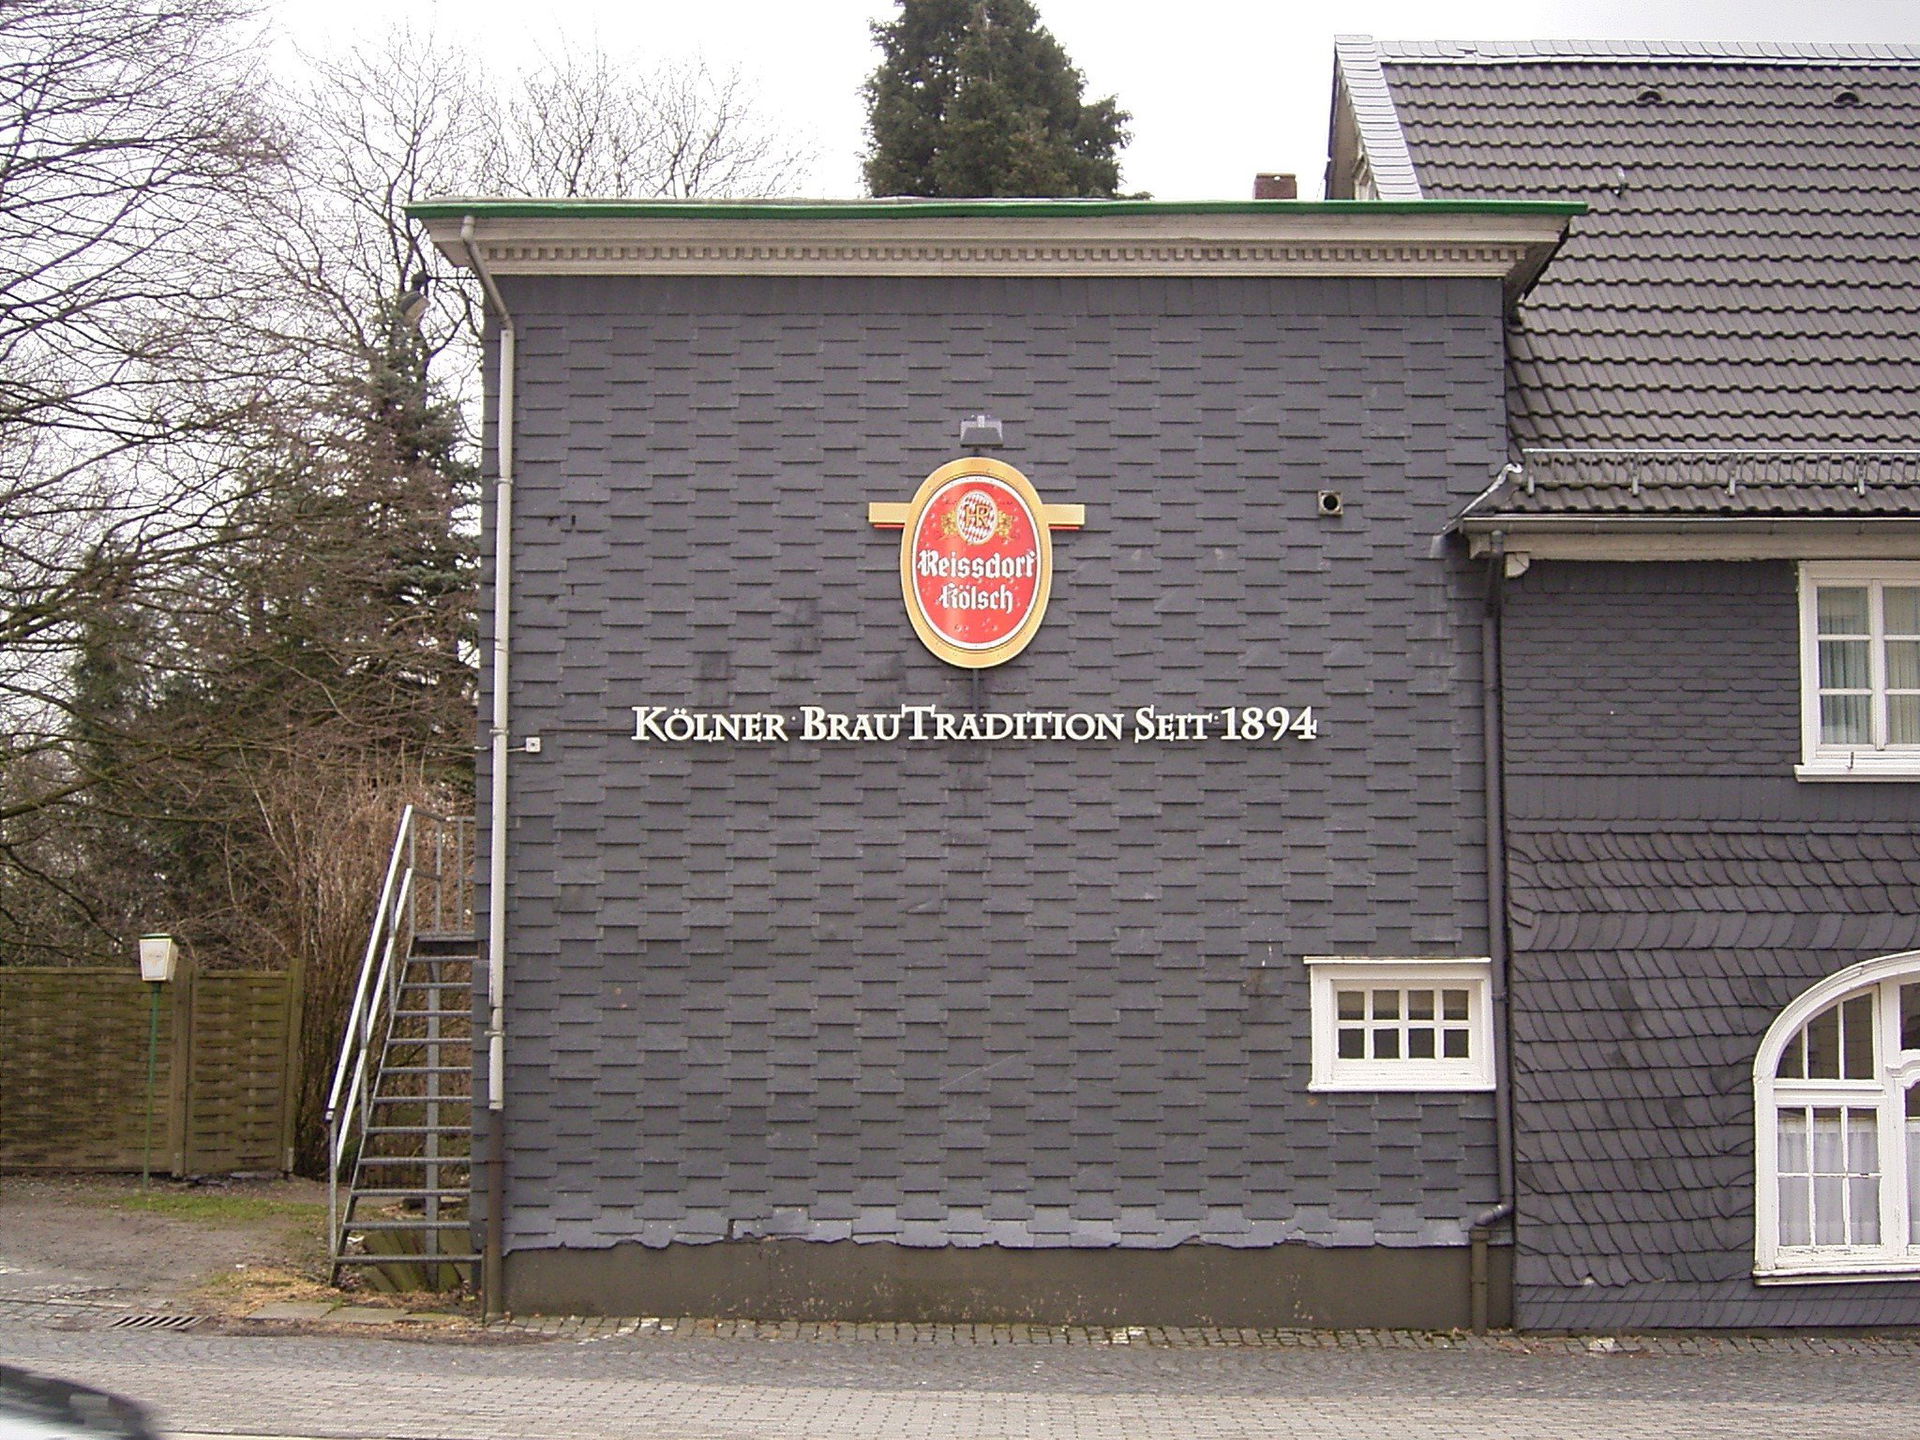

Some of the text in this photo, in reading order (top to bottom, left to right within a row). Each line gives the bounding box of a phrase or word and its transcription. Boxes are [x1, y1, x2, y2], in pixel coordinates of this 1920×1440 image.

[917, 549, 1038, 578] Reissdorf
[937, 583, 1013, 614] Kölsch
[631, 706, 789, 742] KÖLNER
[1134, 704, 1213, 743] SEIT
[1220, 706, 1318, 741] 1894
